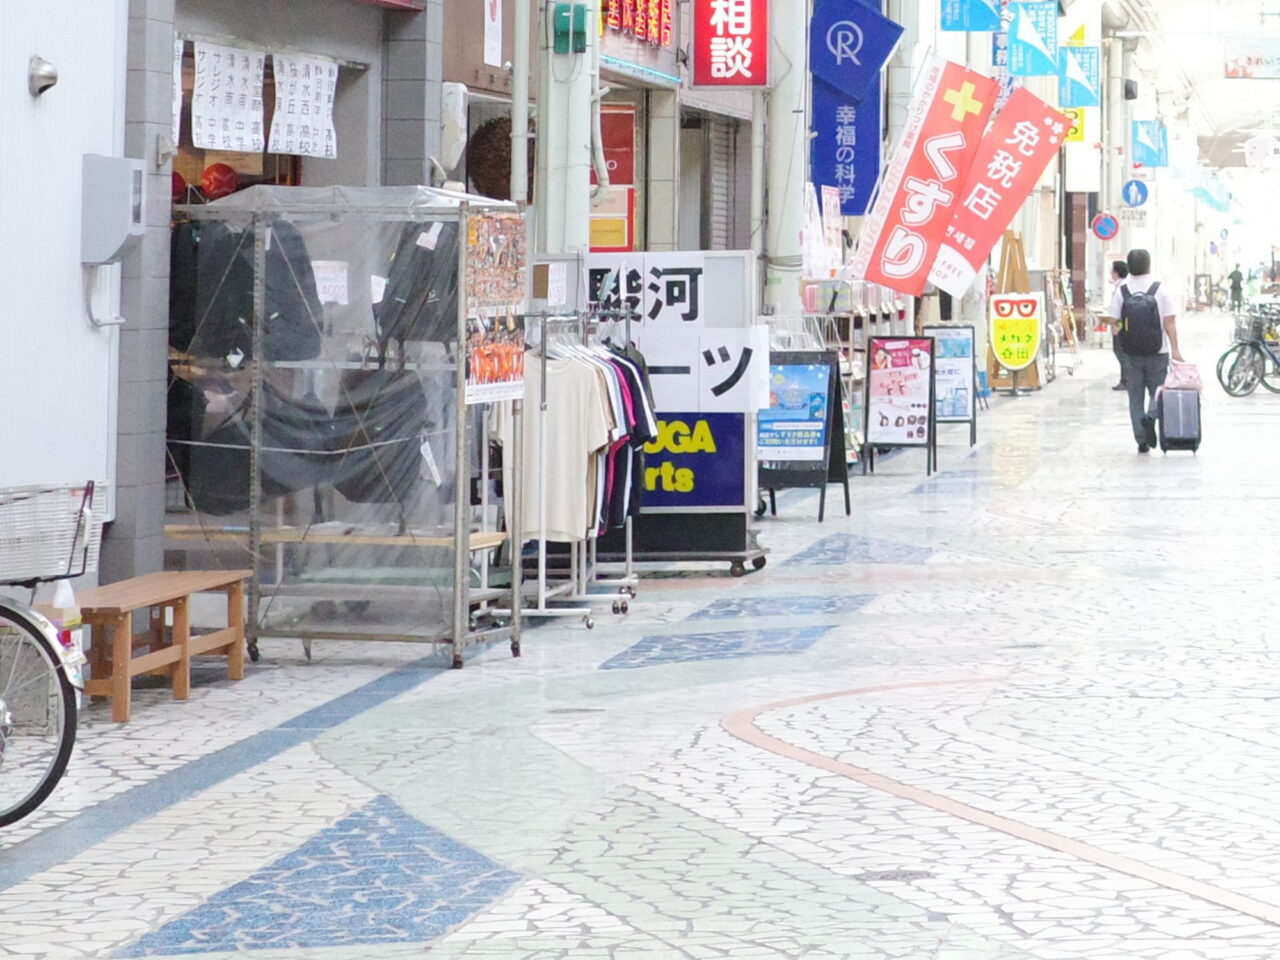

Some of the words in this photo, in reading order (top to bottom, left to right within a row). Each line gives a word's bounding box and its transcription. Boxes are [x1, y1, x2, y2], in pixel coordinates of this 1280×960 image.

[834, 105, 857, 205] 幸福の科学
[963, 119, 1041, 221] 免税店
[881, 131, 966, 280] くすり
[649, 345, 754, 398] ーツ
[643, 420, 717, 454] UGA
[644, 461, 695, 493] rts
